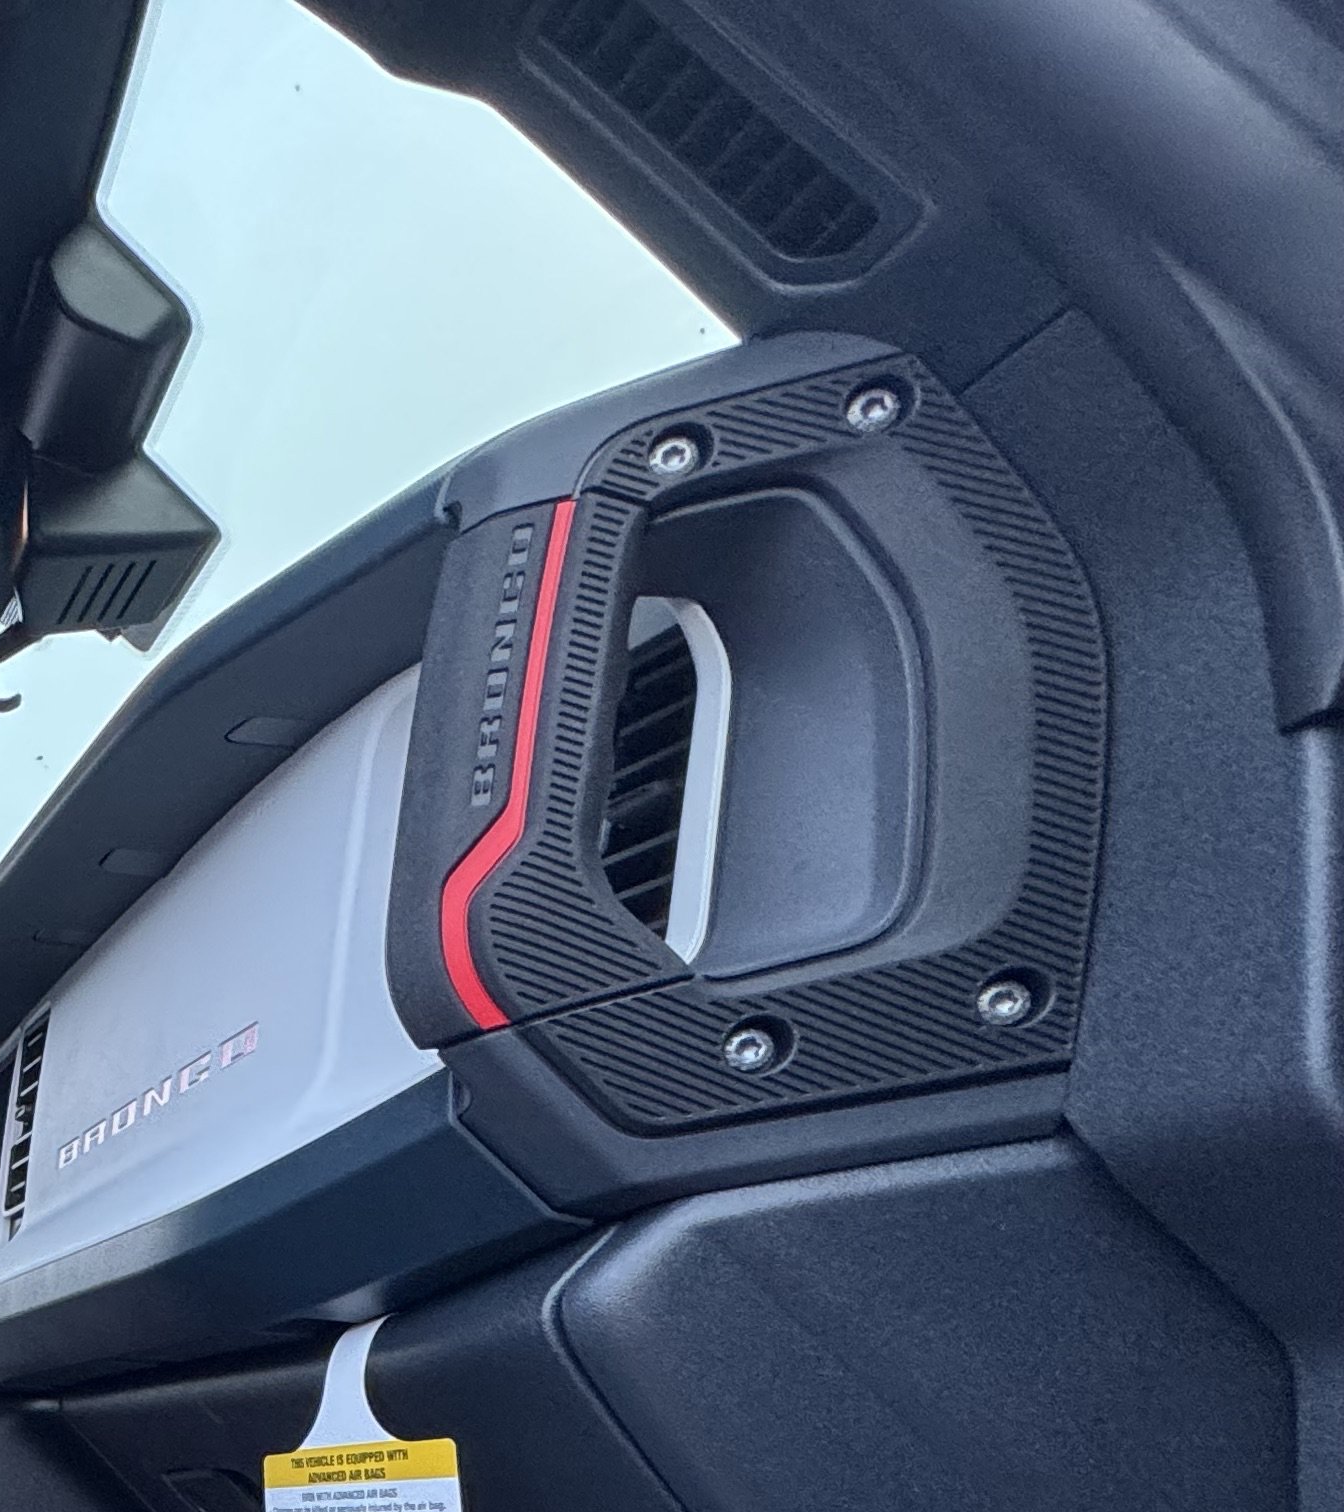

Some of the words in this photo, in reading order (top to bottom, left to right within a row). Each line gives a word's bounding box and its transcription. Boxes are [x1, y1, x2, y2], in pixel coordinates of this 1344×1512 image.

[470, 522, 535, 806] BRONCO
[58, 1021, 259, 1169] BRONCO
[290, 1457, 305, 1469] THIS
[306, 1455, 335, 1468] VEHICLE
[336, 1454, 344, 1465] IS
[346, 1451, 385, 1465] EQUIPPED
[386, 1449, 408, 1461] WITH
[308, 1471, 347, 1483] ADVANCED
[348, 1469, 362, 1481] AIR
[364, 1467, 386, 1480] BAGS
